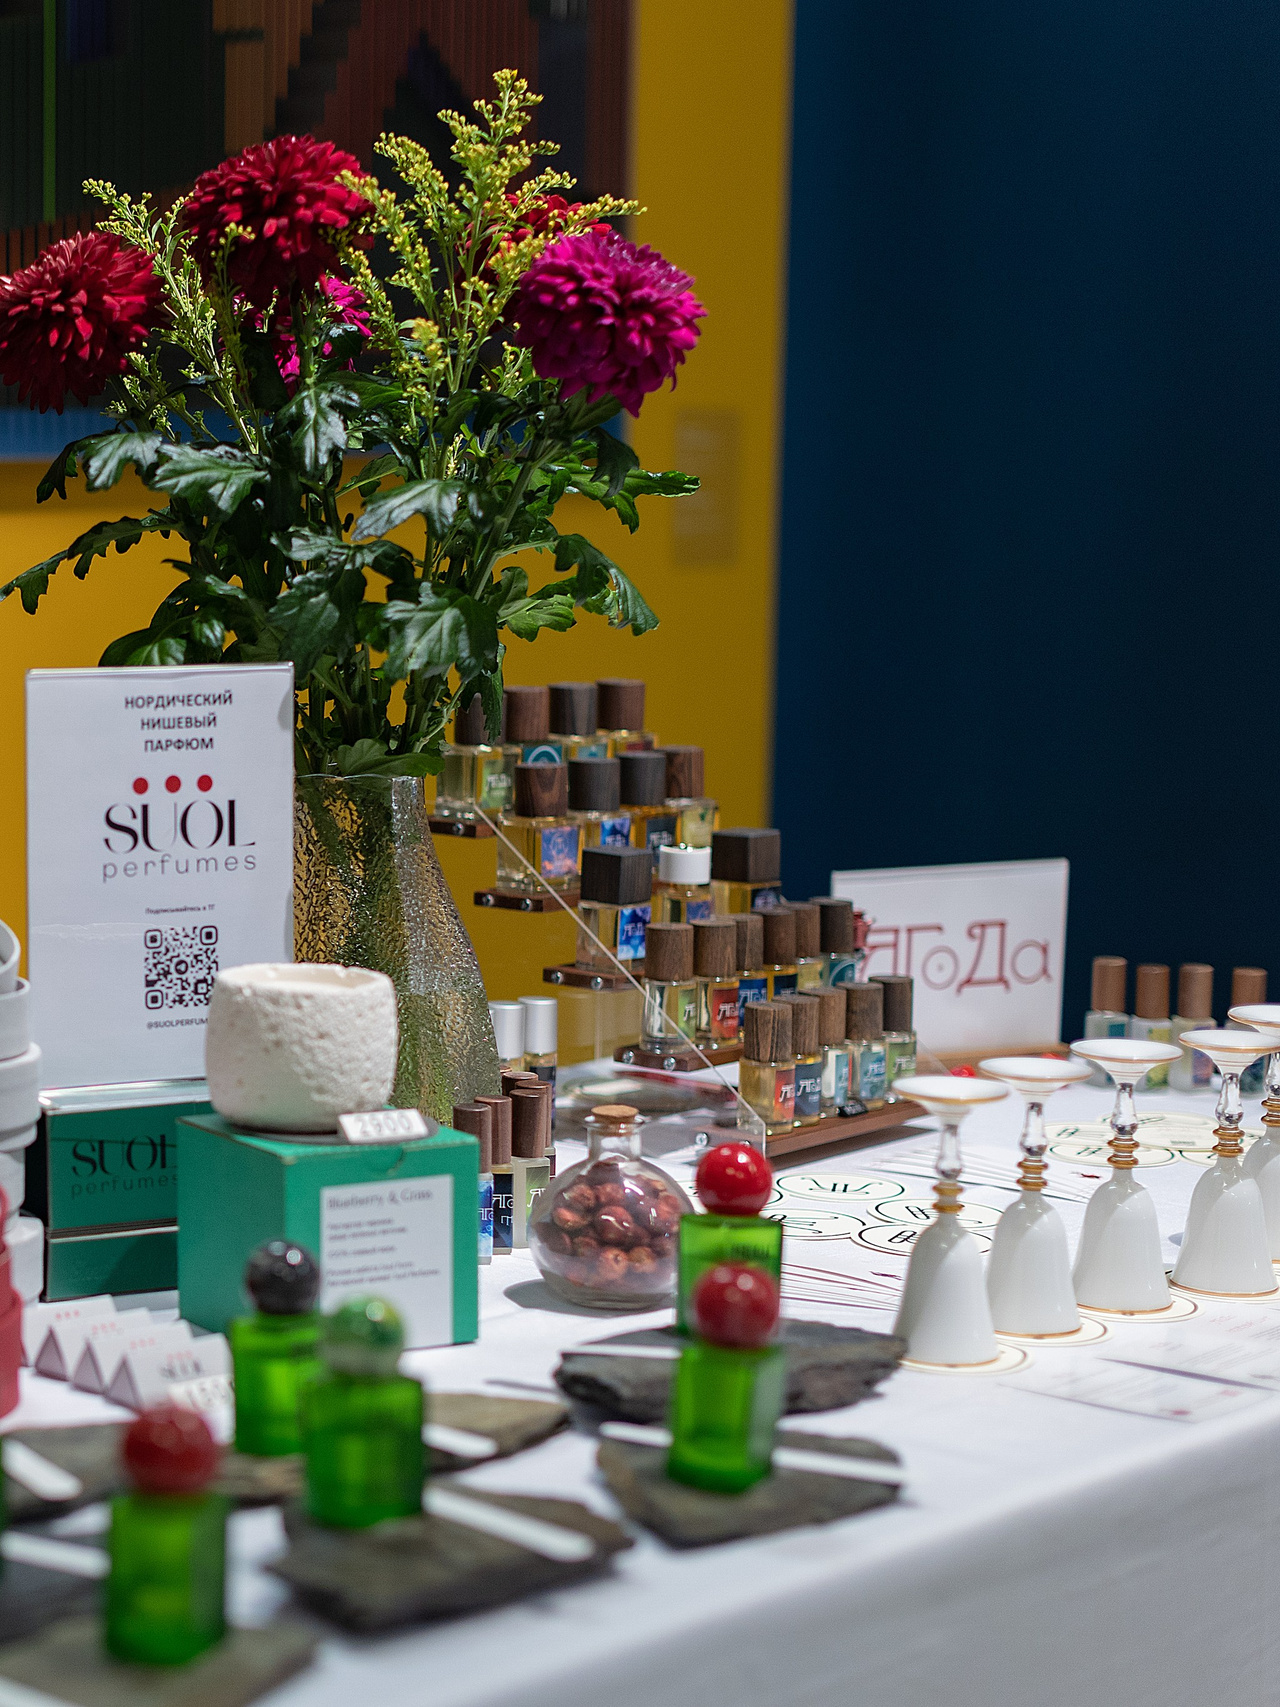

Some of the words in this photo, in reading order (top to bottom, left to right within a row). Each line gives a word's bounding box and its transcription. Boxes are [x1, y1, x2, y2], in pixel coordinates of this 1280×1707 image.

[124, 690, 233, 711] НОРДИЧЕСКИЙ
[140, 713, 218, 731] НИШЕВЫЙ
[144, 737, 214, 753] ПАРФЮМ
[103, 799, 256, 854] SUOL
[102, 853, 257, 884] perfumes
[353, 1111, 413, 1137] 2900
